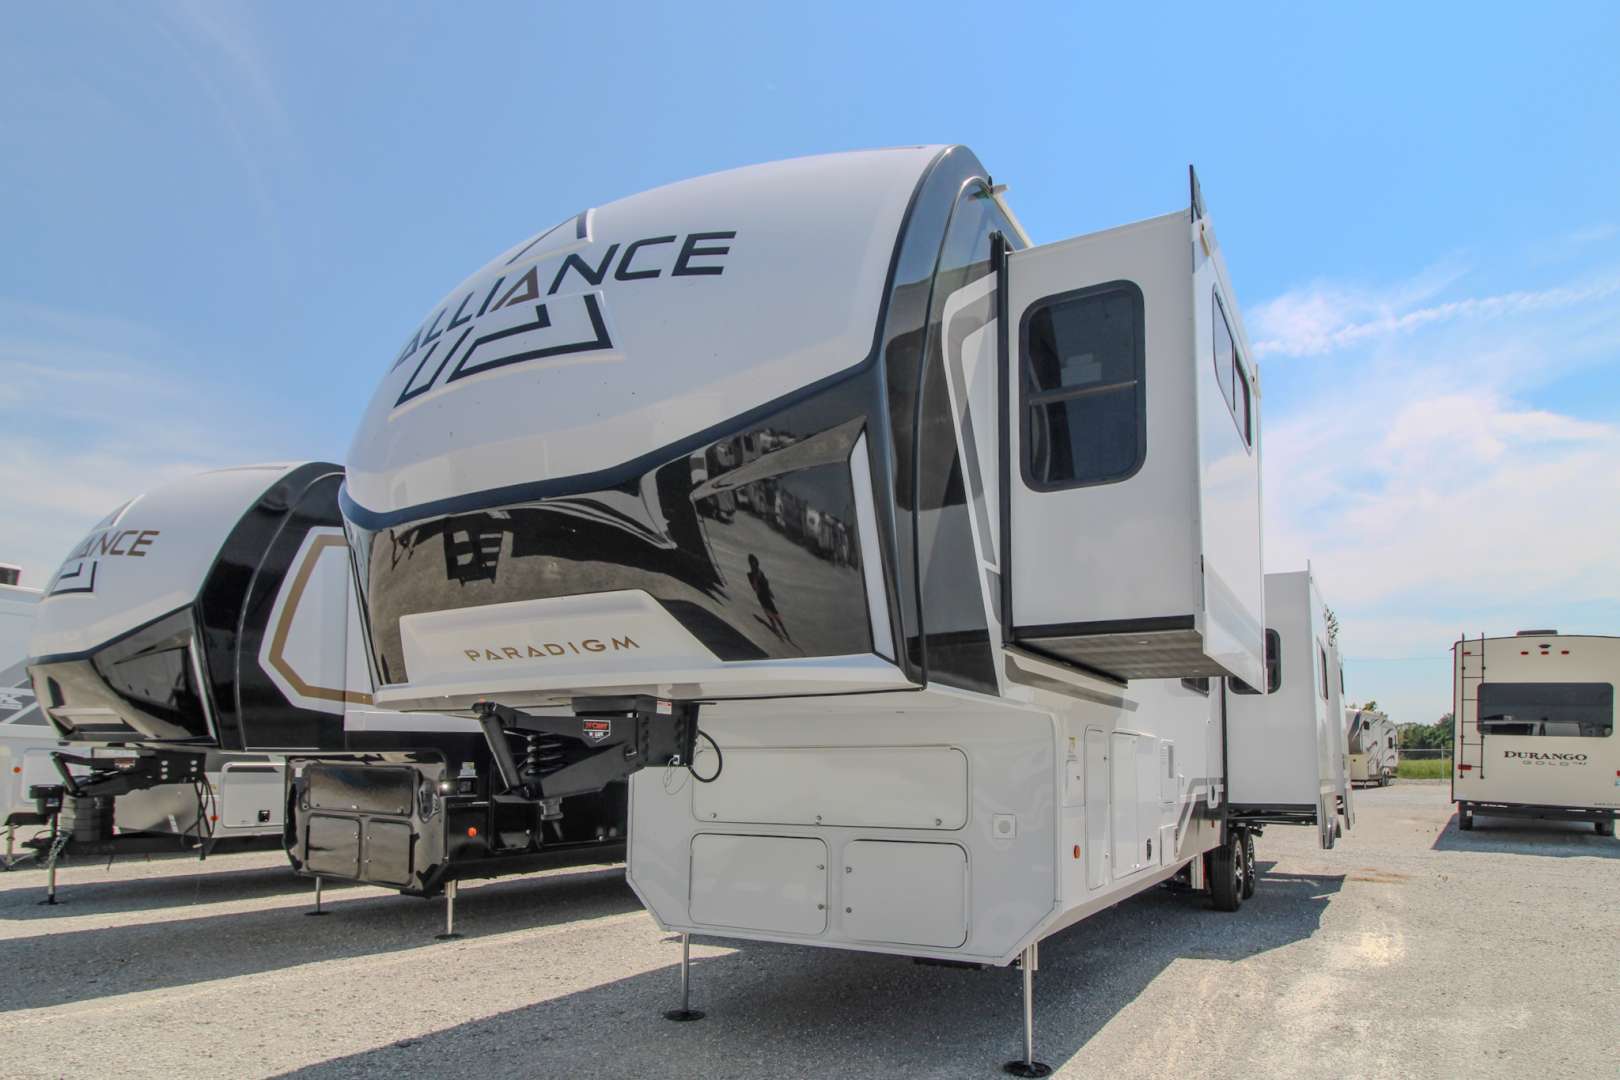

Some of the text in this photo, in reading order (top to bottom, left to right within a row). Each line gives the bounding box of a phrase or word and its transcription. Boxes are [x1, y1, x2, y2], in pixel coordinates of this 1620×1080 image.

[390, 231, 737, 374] ALLIANCE
[464, 636, 640, 662] PARADIGM
[1504, 751, 1588, 761] DURANGO
